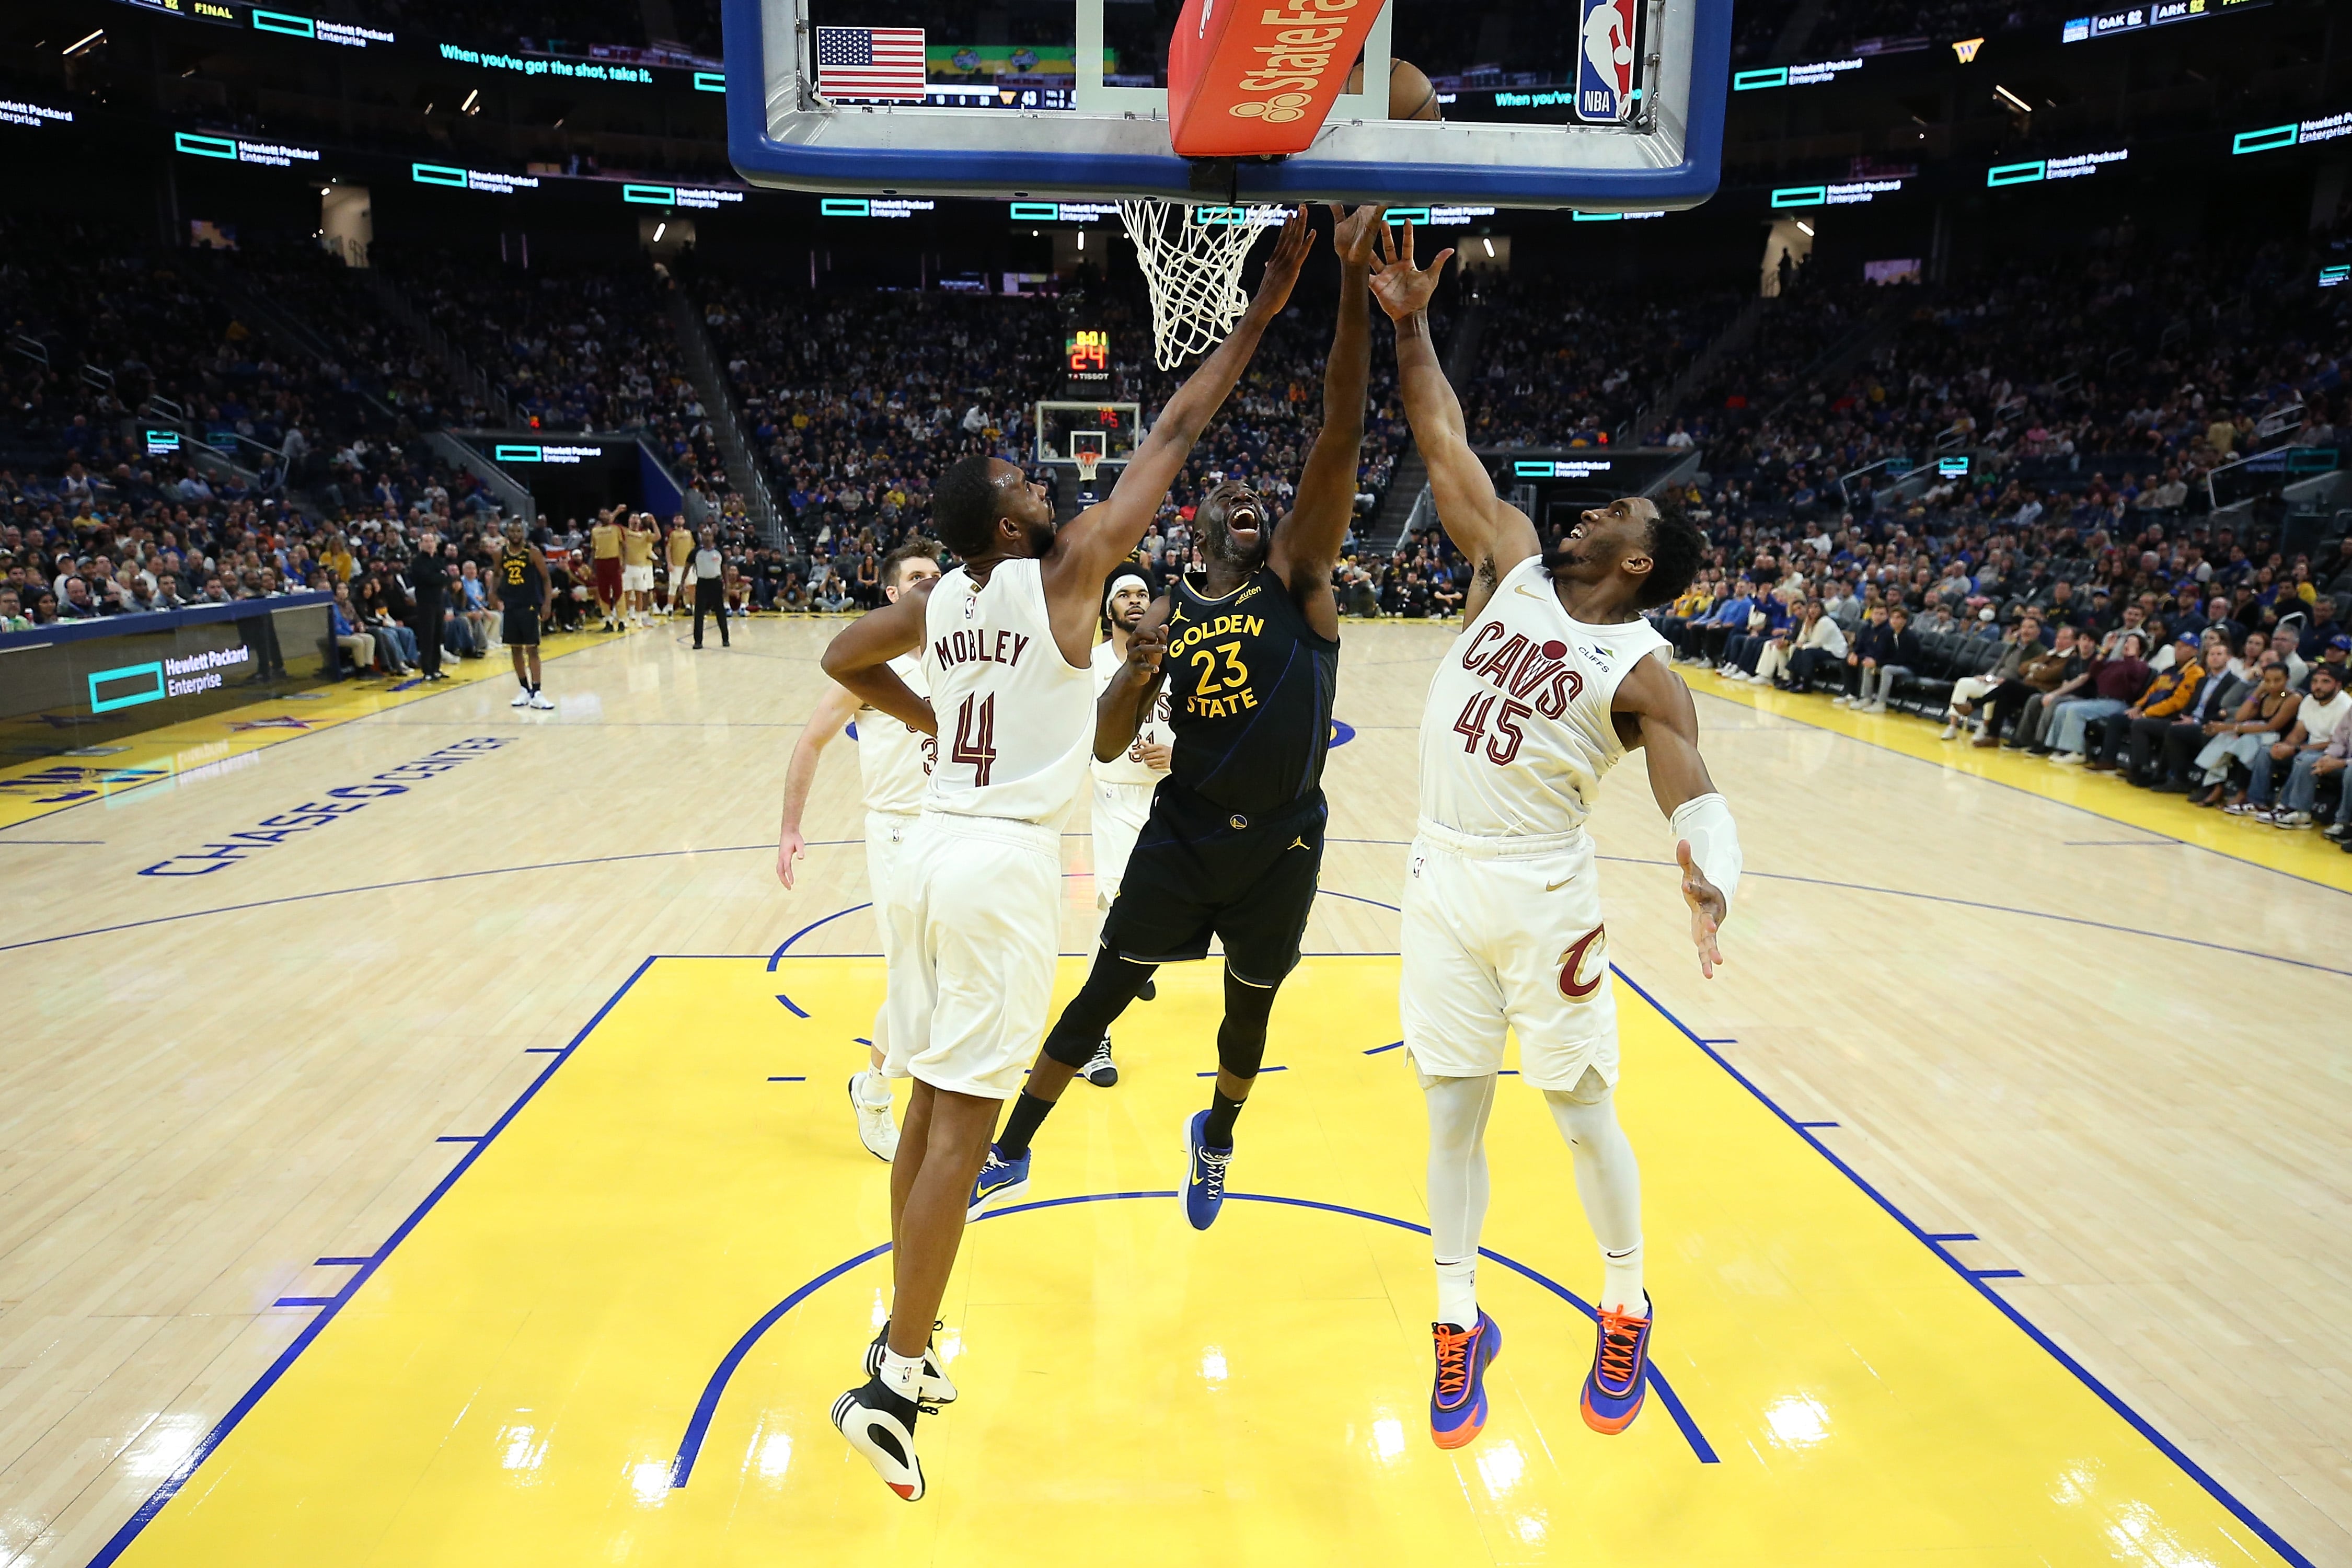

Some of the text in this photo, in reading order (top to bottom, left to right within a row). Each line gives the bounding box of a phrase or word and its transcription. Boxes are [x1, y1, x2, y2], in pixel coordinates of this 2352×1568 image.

[194, 2, 233, 19] FINAL
[2097, 14, 2125, 30] OAK
[2159, 3, 2187, 18] ARK
[316, 20, 394, 42] Hewlett Packard
[317, 30, 366, 47] Enterprise
[440, 43, 652, 83] When you've got the shot, take it.
[1495, 90, 1572, 108] When you've
[1584, 90, 1610, 112] NBA
[29, 104, 73, 121] Packard
[2301, 114, 2343, 132] Hewlett
[2299, 124, 2352, 143] Enterprise
[239, 141, 319, 160] Hewlett Packard
[239, 151, 291, 166] Enterprise
[2047, 148, 2128, 170] Hewlett Packard
[2046, 165, 2096, 179] Enterprise
[1076, 331, 1107, 346] 8:01
[1071, 344, 1105, 370] 24
[508, 567, 522, 578] 22
[1169, 614, 1265, 658] GOLDEN
[165, 644, 249, 676] Hewlett Packard
[934, 629, 1030, 671] MOBLEY
[1578, 646, 1610, 673] CLIFFS
[1191, 640, 1248, 696] 23
[1462, 620, 1583, 720] CAVS
[167, 672, 222, 697] Enterprise
[1187, 687, 1258, 719] STATE
[951, 690, 997, 788] 4
[1452, 689, 1534, 766] 45
[137, 736, 518, 876] CHASE CENTER
